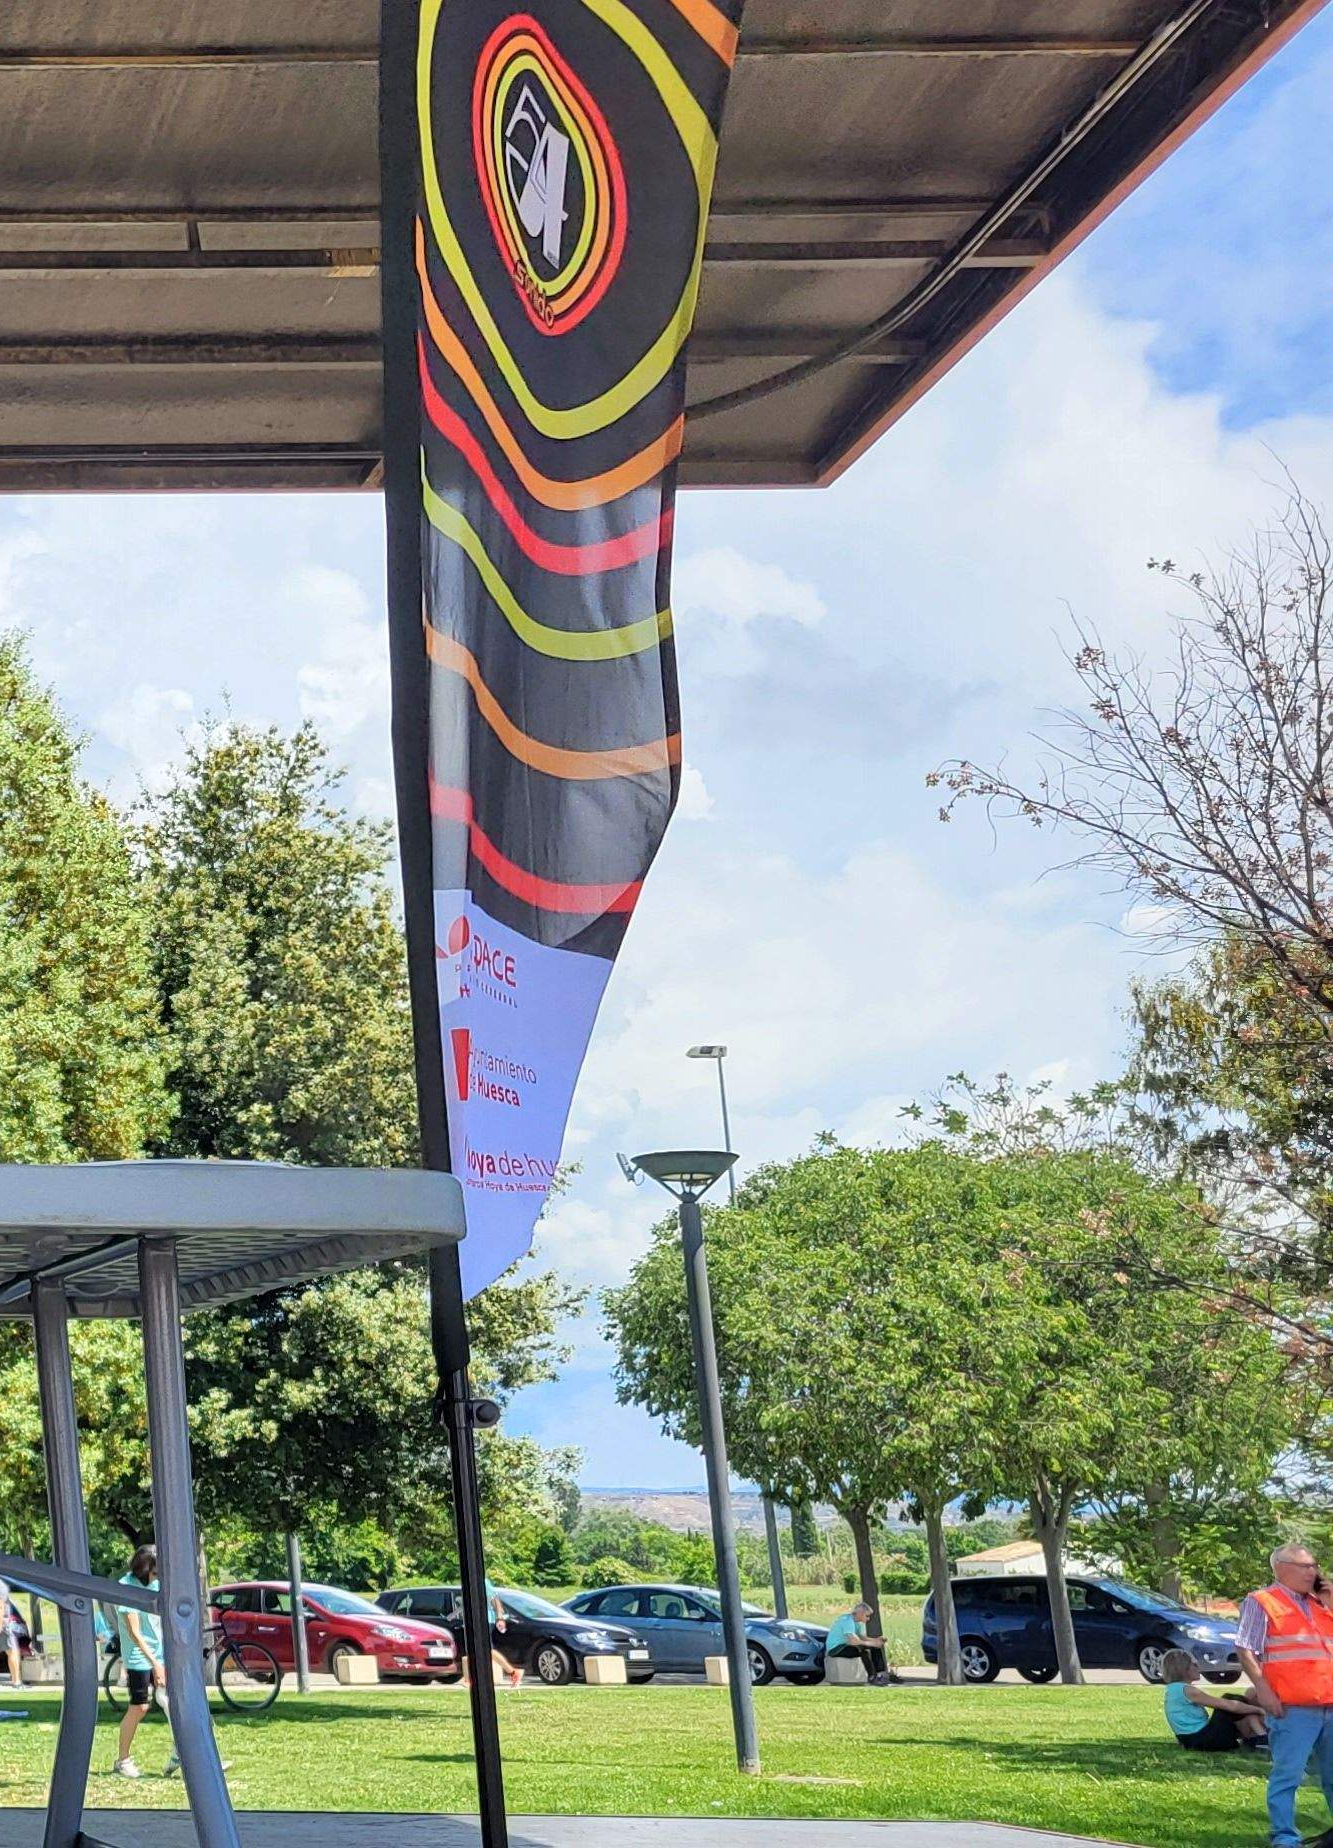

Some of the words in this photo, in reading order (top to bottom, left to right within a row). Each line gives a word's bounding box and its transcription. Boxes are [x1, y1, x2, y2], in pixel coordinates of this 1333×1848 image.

[471, 934, 517, 988] PACE
[477, 1072, 520, 1107] Huesca
[498, 1150, 525, 1177] de
[523, 1152, 559, 1177] hu
